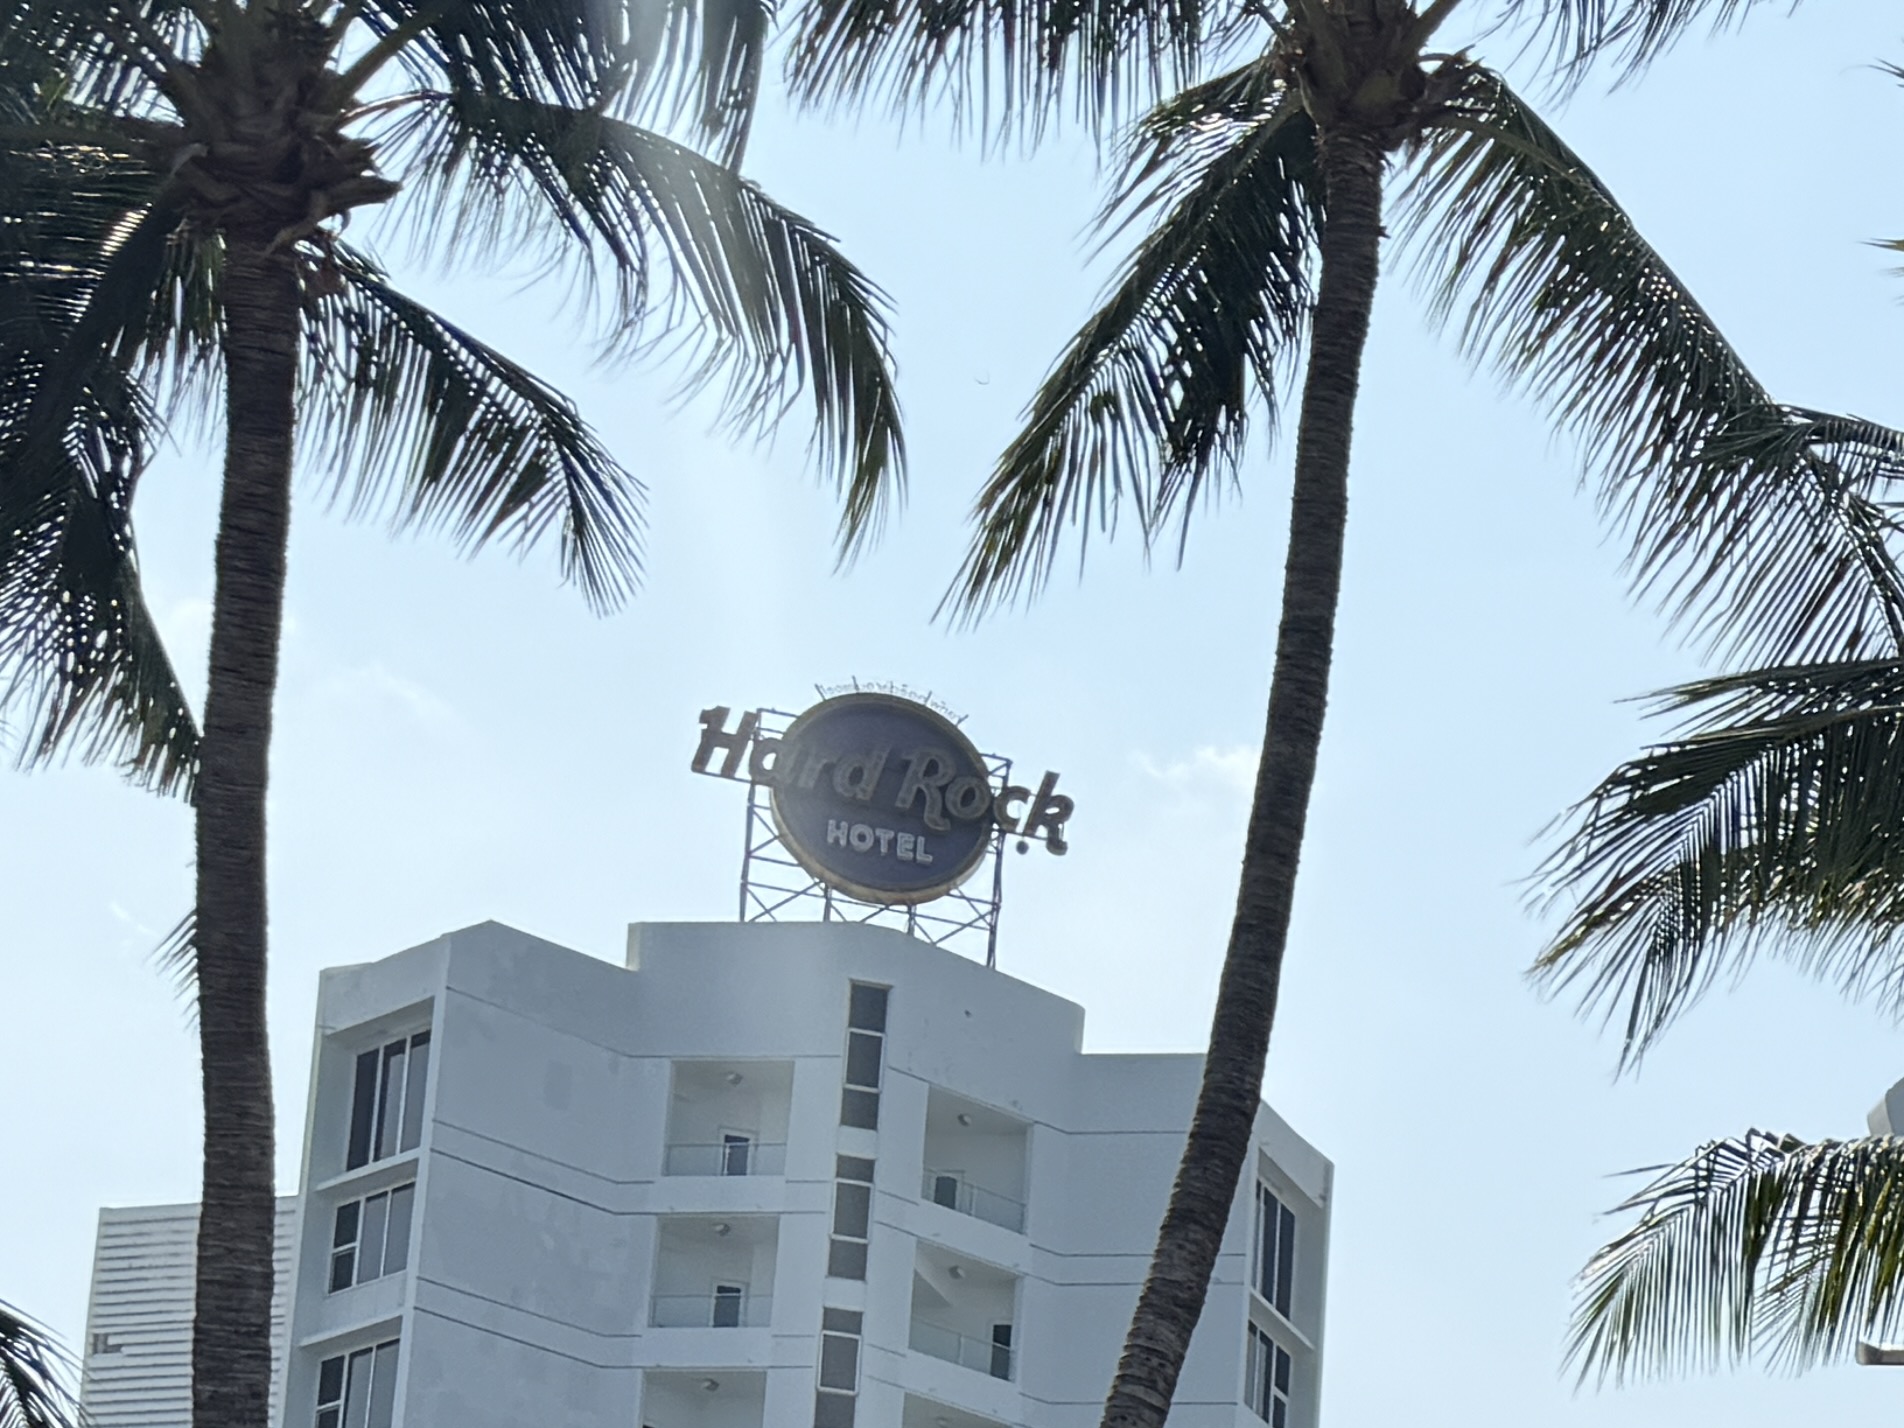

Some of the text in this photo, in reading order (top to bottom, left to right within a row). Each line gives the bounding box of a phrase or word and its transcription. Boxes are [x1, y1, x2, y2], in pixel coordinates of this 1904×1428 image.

[691, 706, 1075, 856] Hard Rock
[827, 819, 933, 864] HOTEL
